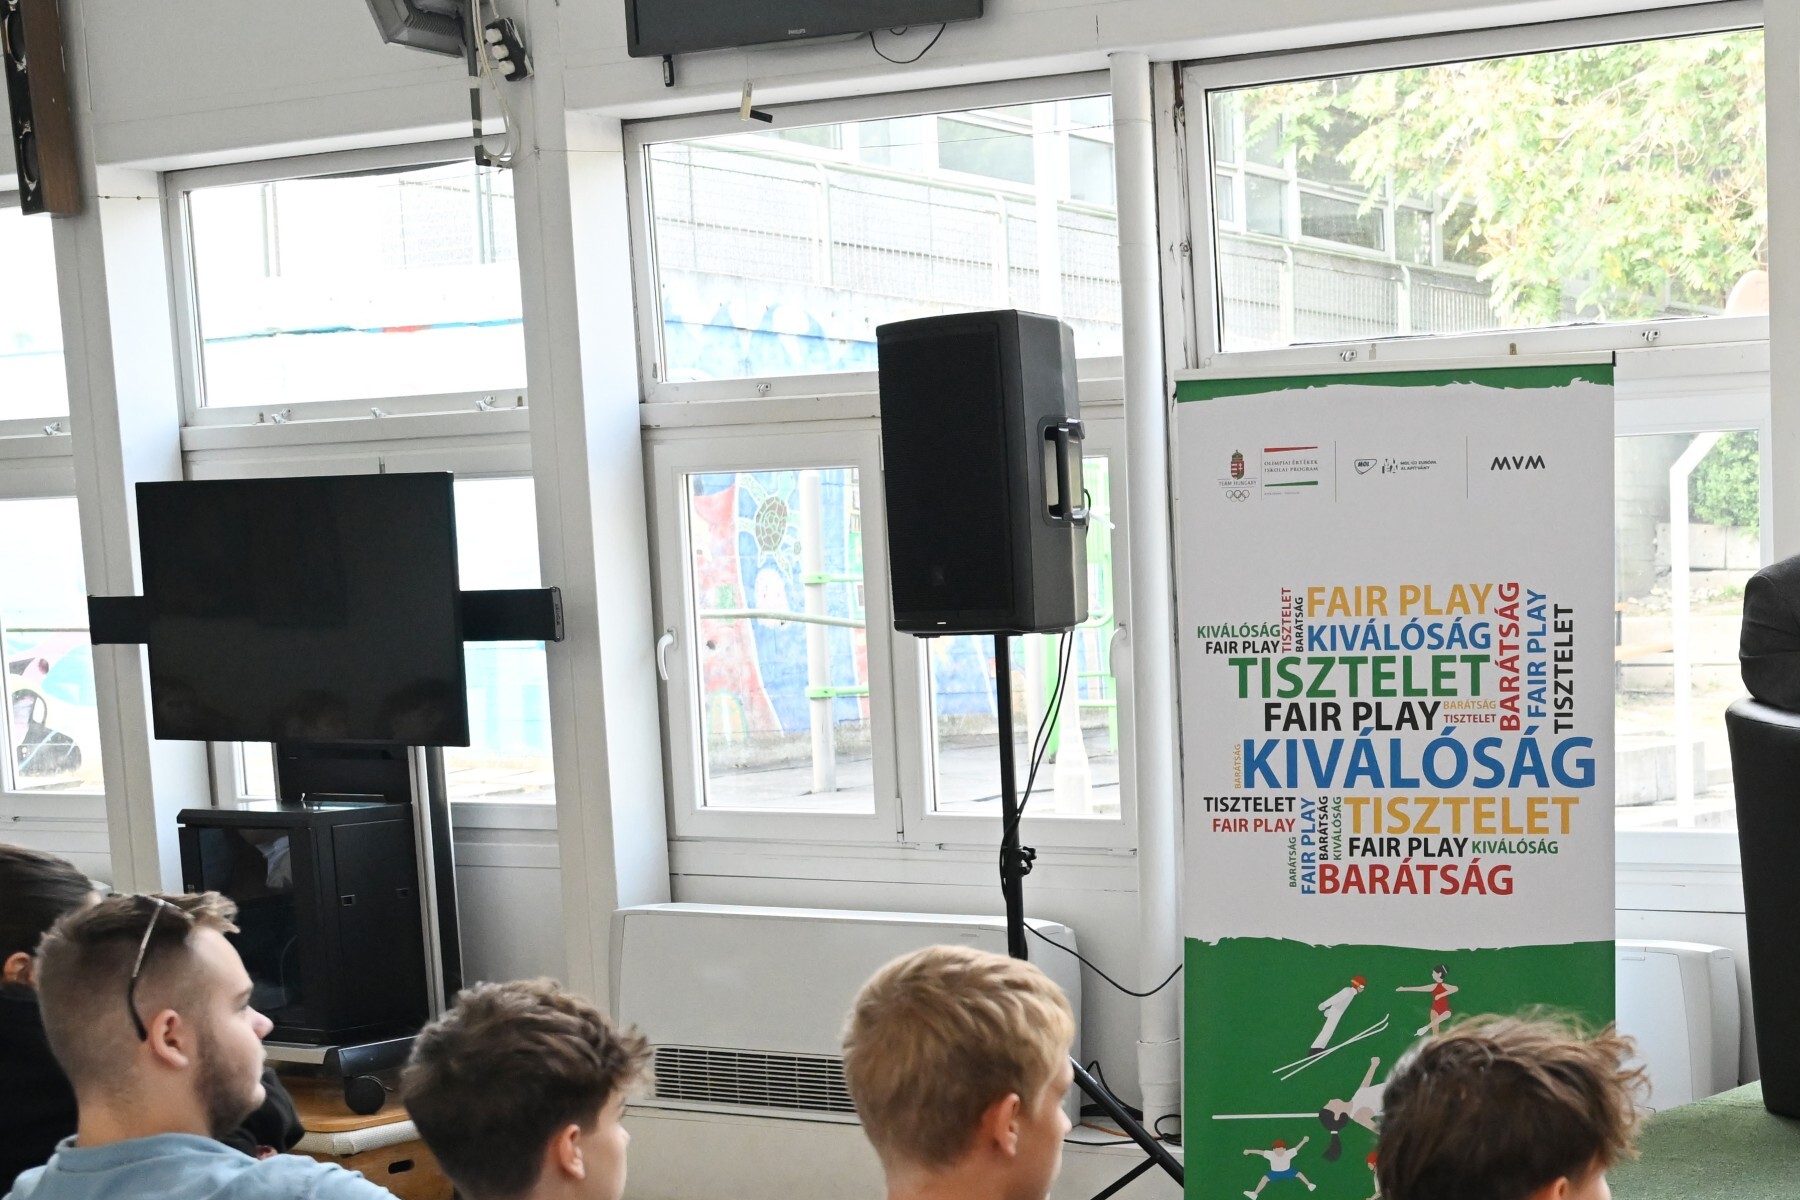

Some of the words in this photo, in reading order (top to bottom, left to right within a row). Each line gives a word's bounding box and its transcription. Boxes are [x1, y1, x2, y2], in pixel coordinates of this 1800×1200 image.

[1357, 460, 1370, 468] MOL
[1490, 455, 1546, 471] MVM
[1308, 586, 1387, 617] FAIR
[1400, 584, 1493, 615] PLAY
[1198, 623, 1280, 638] KIVÁLÓSÁG
[1282, 588, 1291, 653] TISZTELET
[1294, 597, 1303, 652] BARÁTSÁG
[1308, 618, 1490, 651] KIVÁLÓSÁG
[1527, 589, 1546, 653] PLAY
[1206, 641, 1238, 654] FAIR
[1243, 641, 1280, 653] PLAY
[1495, 583, 1520, 731] BARÁTSÁG
[1229, 655, 1490, 698] TISZTELET
[1554, 604, 1573, 734] TISZTELET
[1444, 700, 1496, 709] BARÁTSÁG
[1527, 662, 1546, 717] FAIR
[1265, 702, 1341, 731] FAIR
[1353, 701, 1441, 732] PLAY
[1444, 714, 1496, 723] TISZTELET
[1244, 726, 1595, 788] KIVÁLÓSÁG
[1204, 797, 1296, 812] TISZTELET
[1301, 798, 1315, 845] PLAY
[1344, 797, 1579, 834] TISZTELET
[1213, 819, 1248, 832] FAIR
[1254, 819, 1295, 832] PLAY
[1318, 796, 1328, 860] BARÁTSÁG
[1333, 797, 1341, 860] KIVÁLÓSÁG
[1288, 837, 1296, 887] BARÁTSÁG
[1349, 838, 1400, 857] FAIR
[1409, 838, 1468, 857] PLAY
[1472, 839, 1558, 854] KIVÁLÓSÁG
[1301, 852, 1315, 894] FAIR
[1319, 857, 1513, 895] BARÁTSÁG
